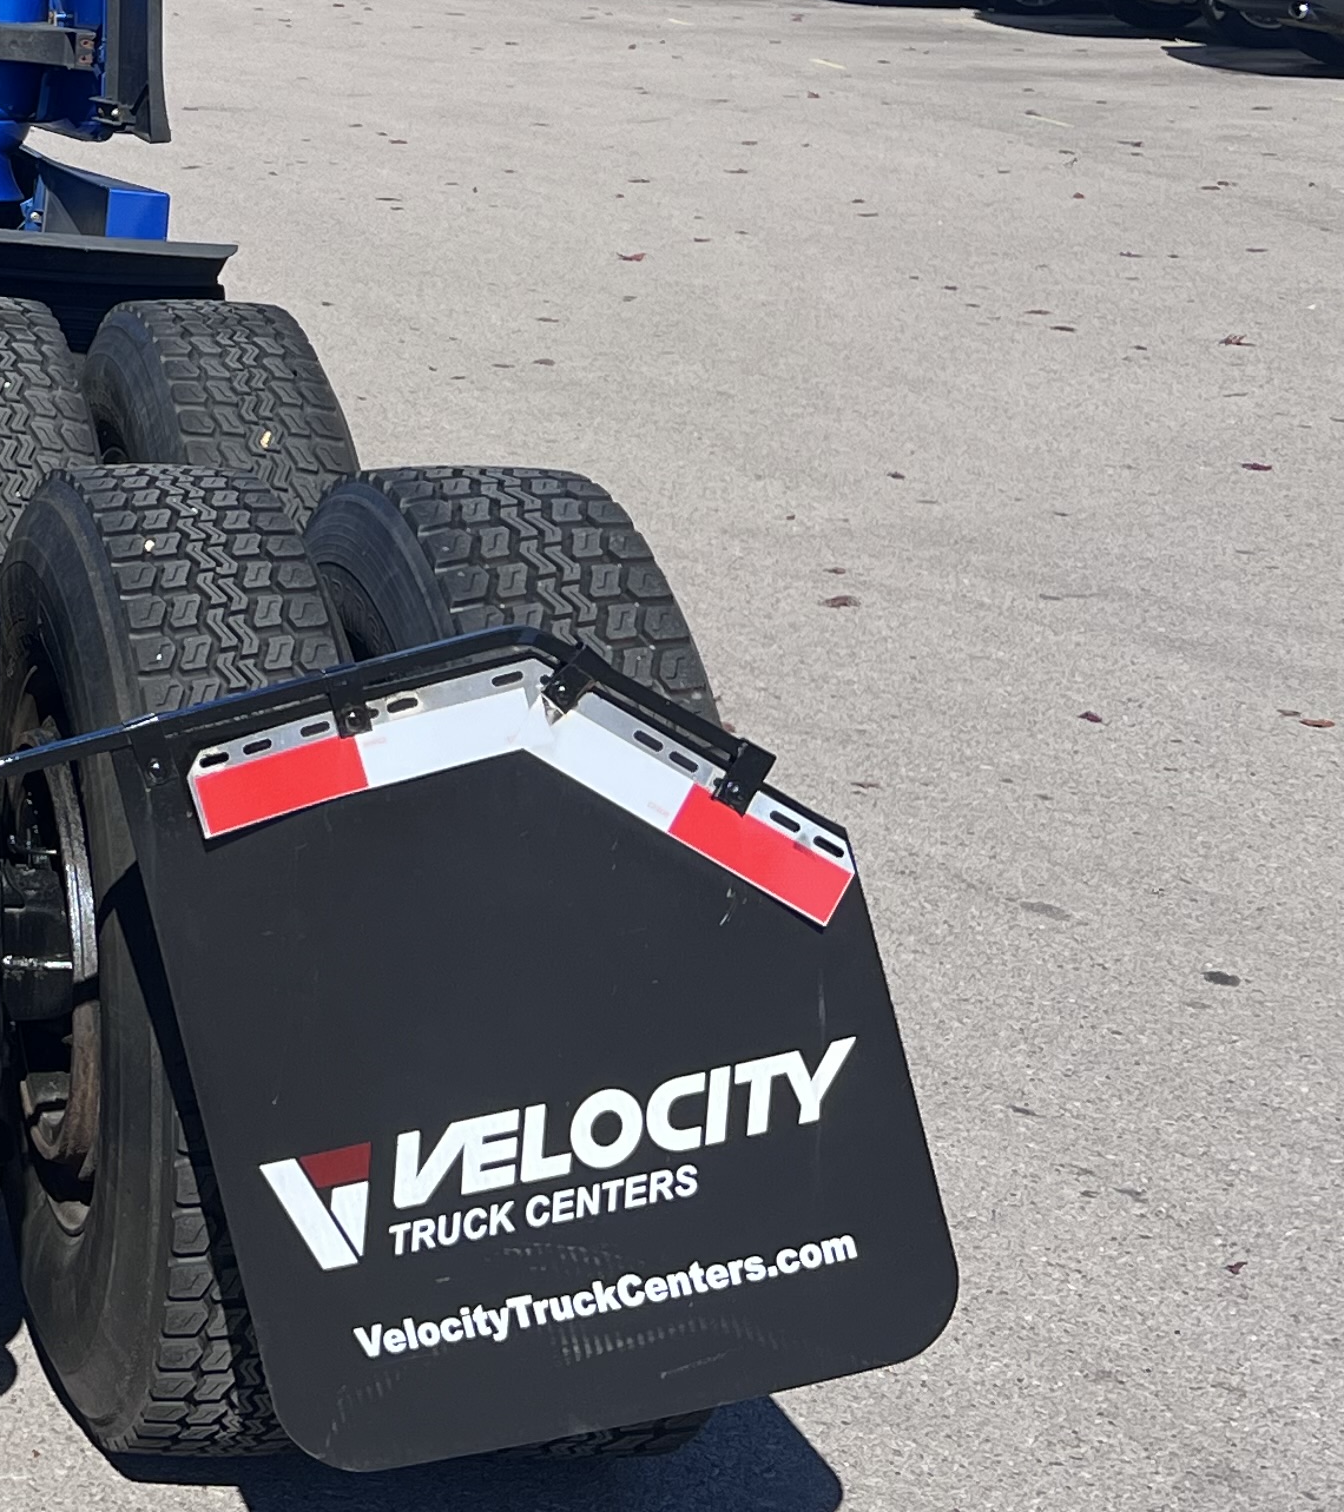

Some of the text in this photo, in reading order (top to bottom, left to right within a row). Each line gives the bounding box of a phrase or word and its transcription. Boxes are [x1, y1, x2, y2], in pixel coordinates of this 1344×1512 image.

[393, 1036, 858, 1209] VELOCITY
[388, 1164, 699, 1256] TRUCK CENTERS
[353, 1234, 858, 1358] VelocityTruckCenters.com
